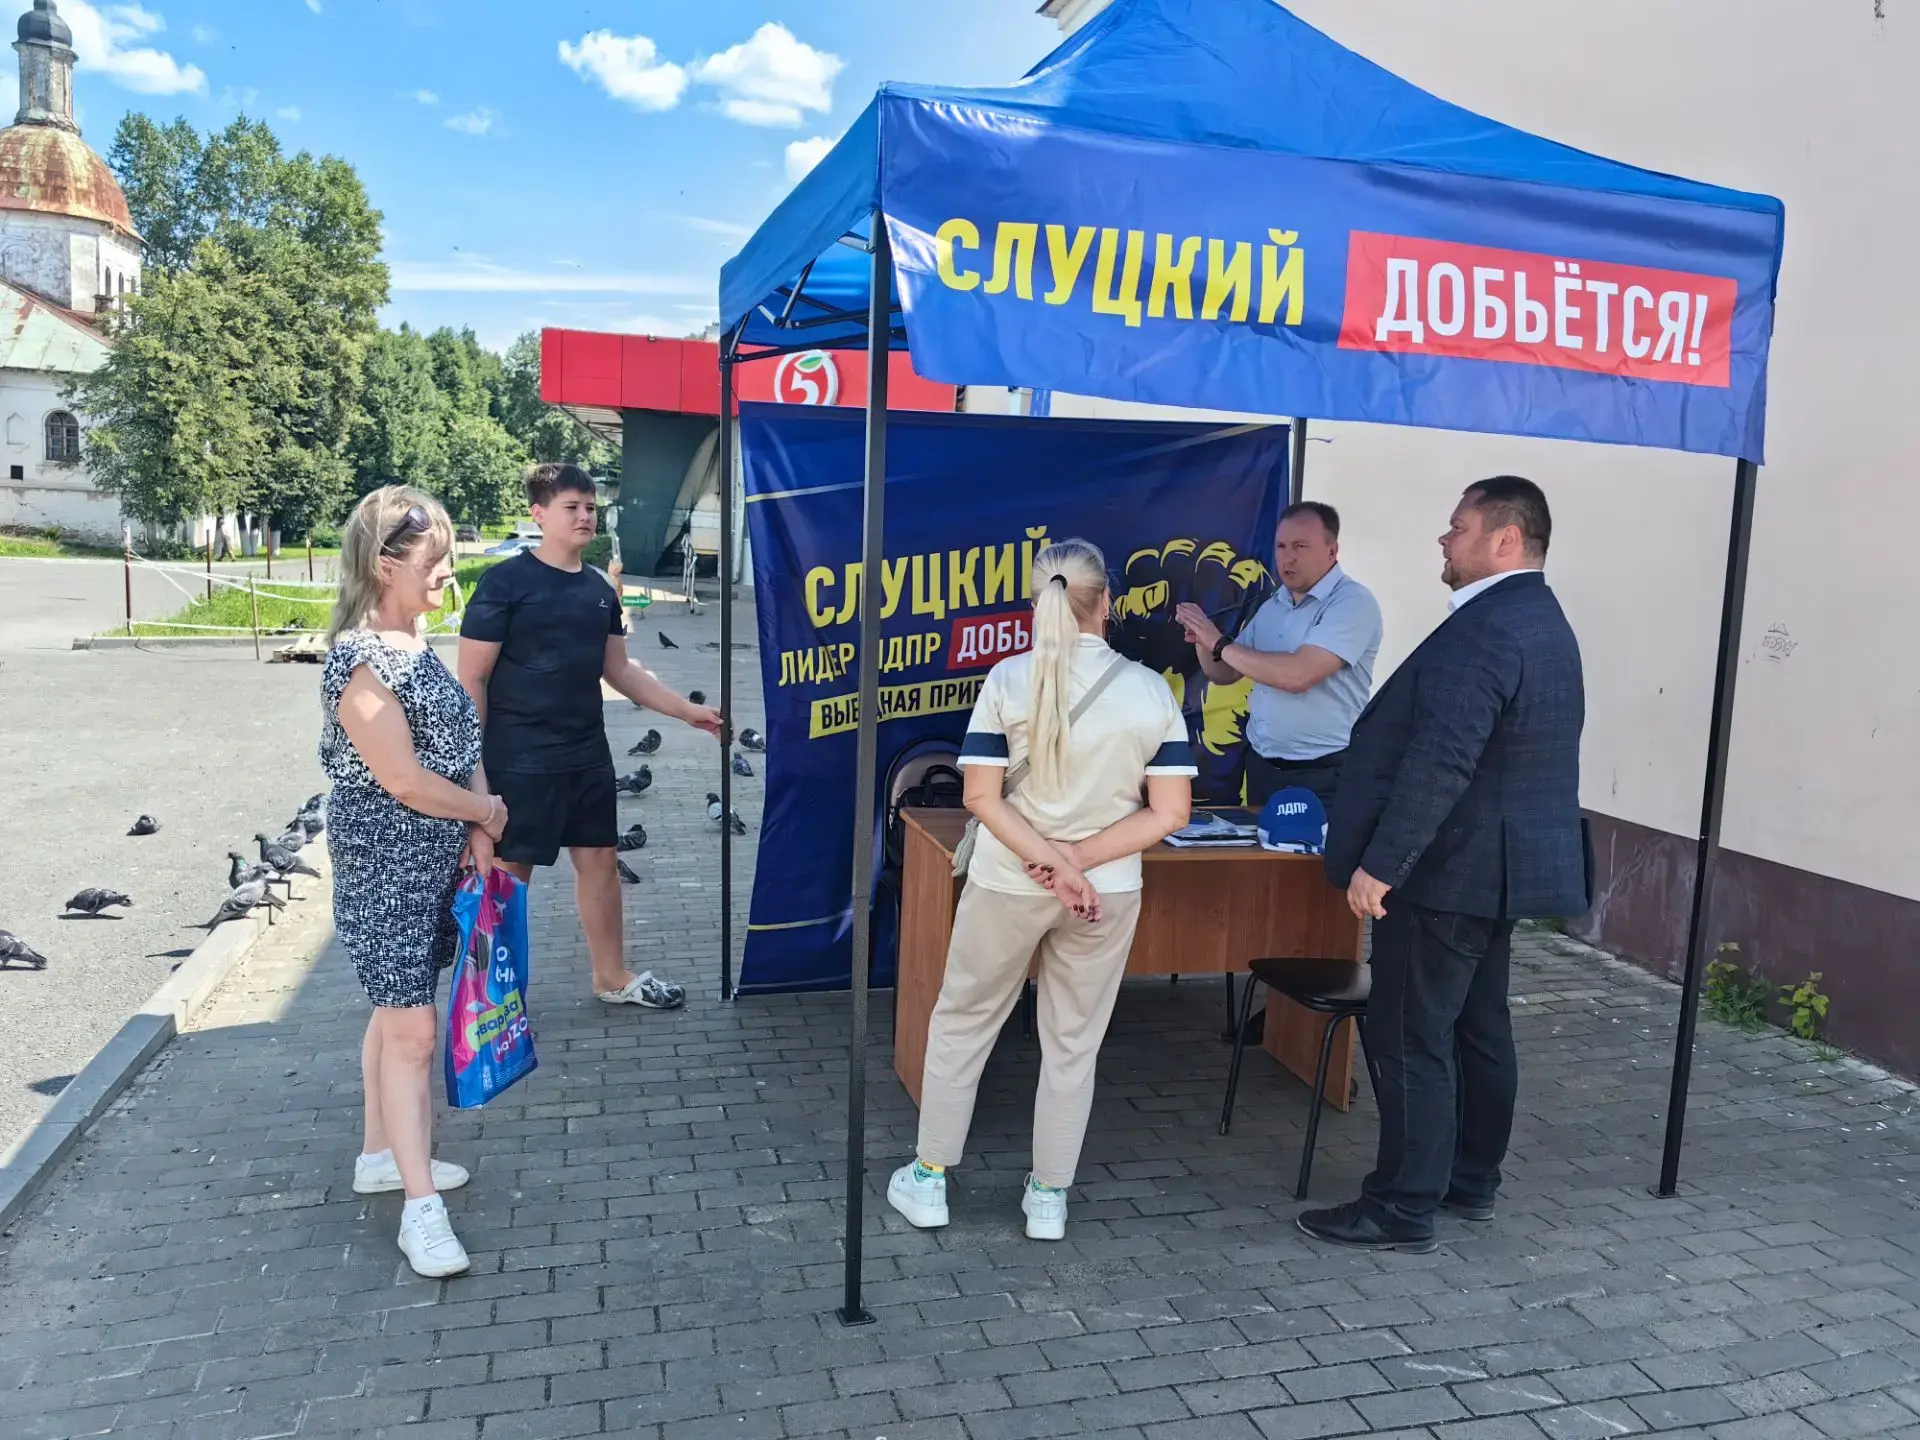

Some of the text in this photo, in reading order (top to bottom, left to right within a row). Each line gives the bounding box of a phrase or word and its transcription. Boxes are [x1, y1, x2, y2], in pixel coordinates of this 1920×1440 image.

[935, 217, 1709, 366] СЛУЦКИЙ ДОБЬЁТСЯ!
[778, 642, 856, 687] ЛИДЕР
[956, 619, 1036, 663] ДОБЬ
[821, 687, 922, 730] ВЫЕНАЯ
[1276, 801, 1309, 816] ЛДПР
